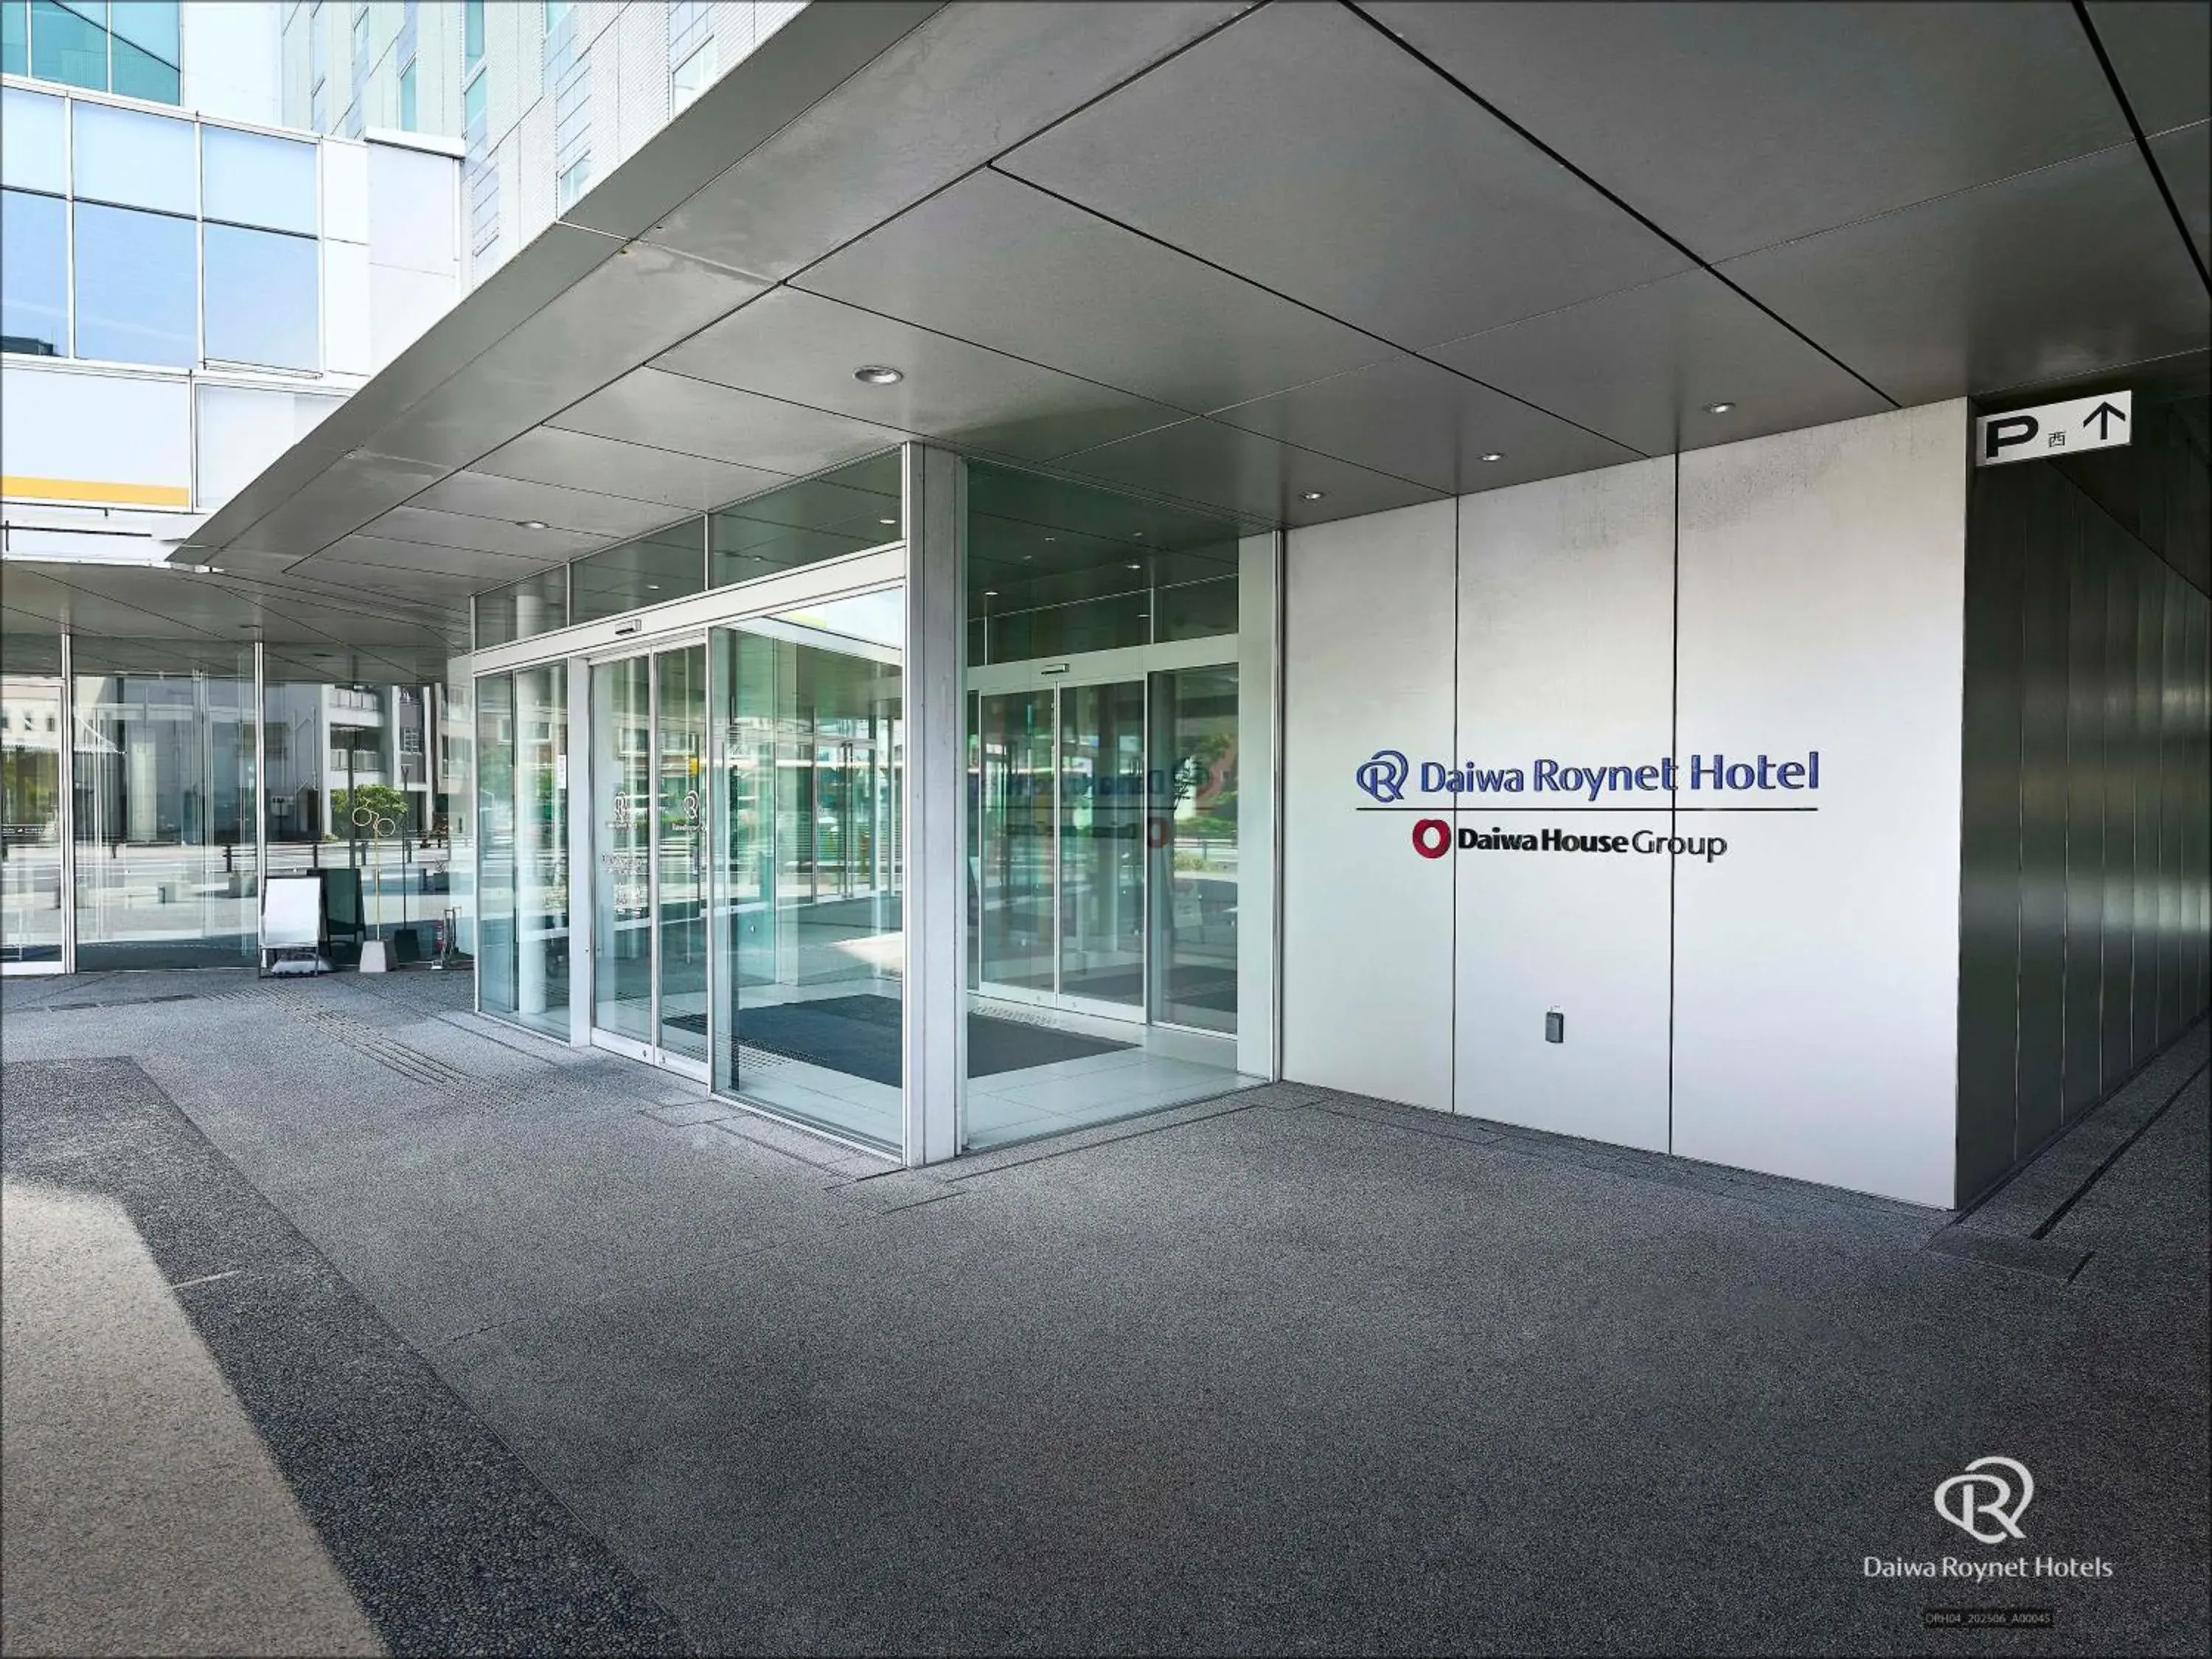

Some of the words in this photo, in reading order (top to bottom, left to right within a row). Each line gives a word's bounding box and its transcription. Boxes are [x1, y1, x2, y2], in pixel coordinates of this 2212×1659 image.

[1986, 415, 2039, 459] P
[2048, 431, 2066, 448] 西
[1421, 760, 1524, 793] Daiwa
[1534, 758, 1679, 801] Roynet
[1691, 751, 1819, 790] Hotel
[1632, 830, 1728, 863] Group
